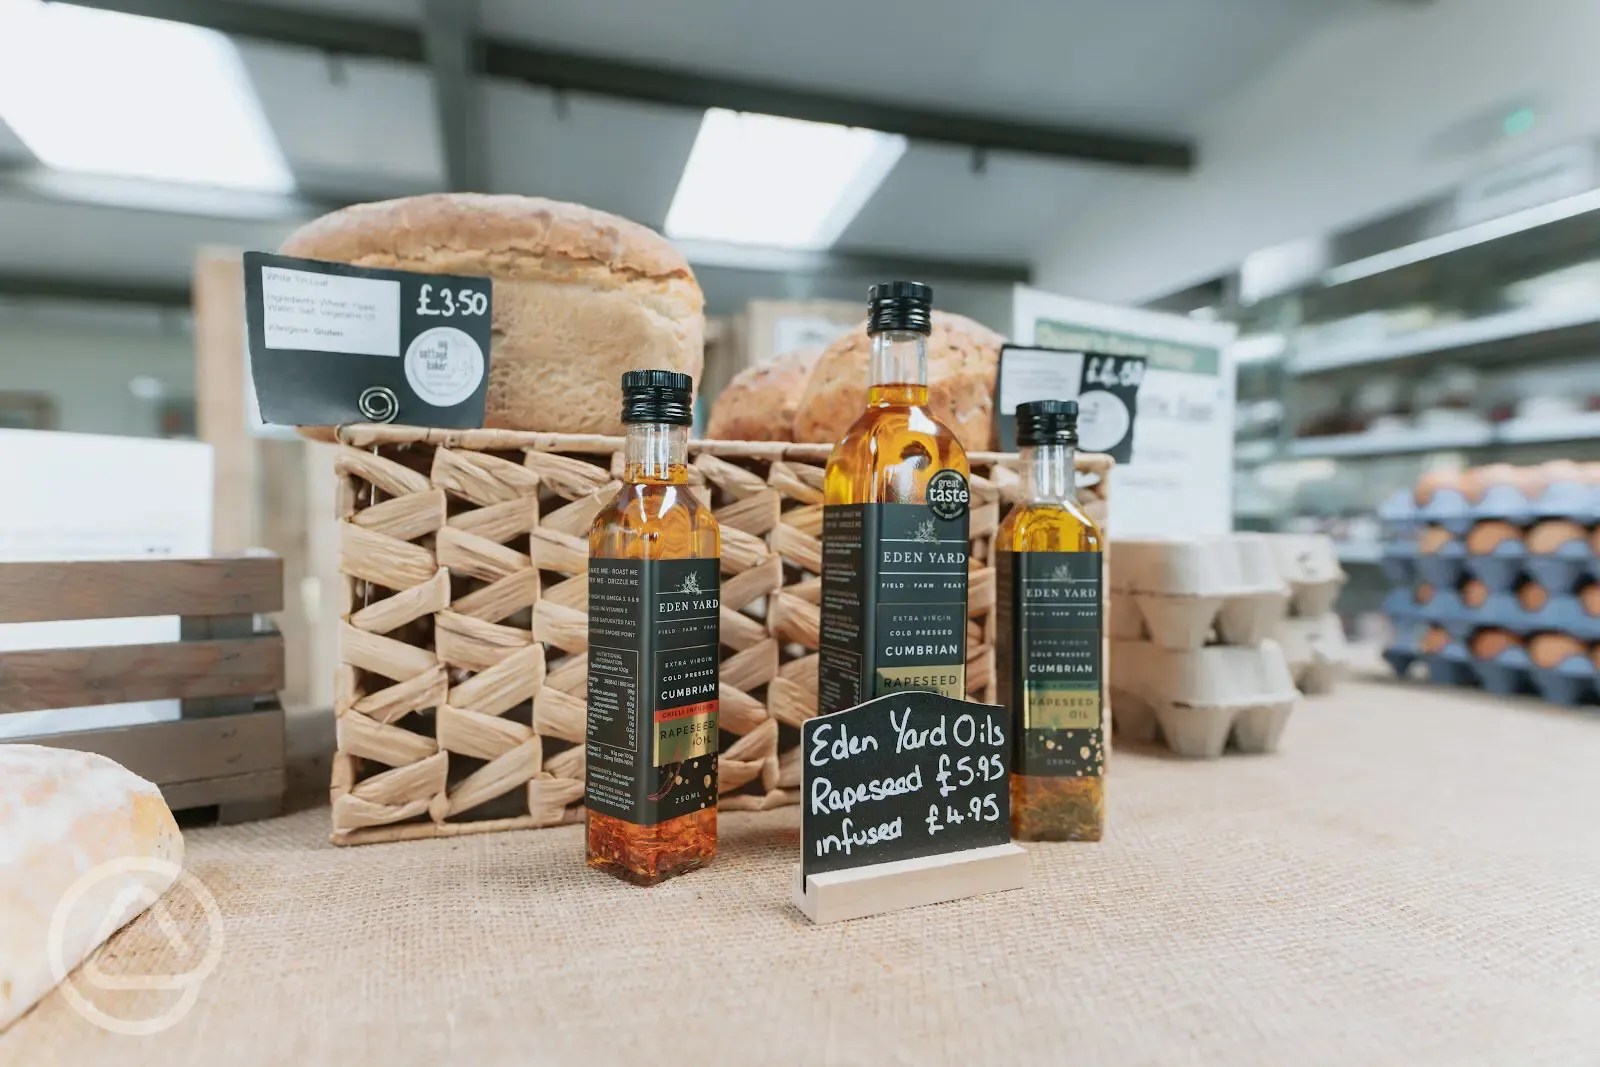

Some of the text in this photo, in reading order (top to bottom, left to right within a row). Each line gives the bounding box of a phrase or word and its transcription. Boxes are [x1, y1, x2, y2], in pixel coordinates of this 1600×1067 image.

[416, 283, 488, 318] £3.50
[938, 479, 960, 490] great
[930, 487, 968, 503] taste
[883, 551, 966, 564] EDEN YARD
[611, 568, 629, 576] ROAST
[607, 578, 629, 586] DRIZZLE
[606, 594, 622, 602] OMEGA
[1025, 588, 1097, 598] EDEN YARD
[659, 599, 719, 613] EDEN YARD
[923, 614, 952, 622] VIRGIN
[885, 644, 958, 656] CUMBRIAN
[664, 656, 713, 669] EXTRA VIRGIN
[1029, 664, 1093, 673] CUMBRIAN
[662, 668, 714, 682] COLD PRESSED
[884, 675, 957, 688] RAPESEED
[661, 683, 715, 700] CUMBRIAN
[1030, 697, 1093, 707] RAPESEED
[1069, 710, 1089, 719] OIL
[660, 720, 715, 740] RAPESEED
[809, 706, 1005, 767] Eden Yard Oils
[695, 735, 712, 746] OIL
[811, 753, 1005, 816] Rapeseed £5.95
[675, 791, 701, 804] 250ML
[816, 793, 1000, 857] infused £4.95
